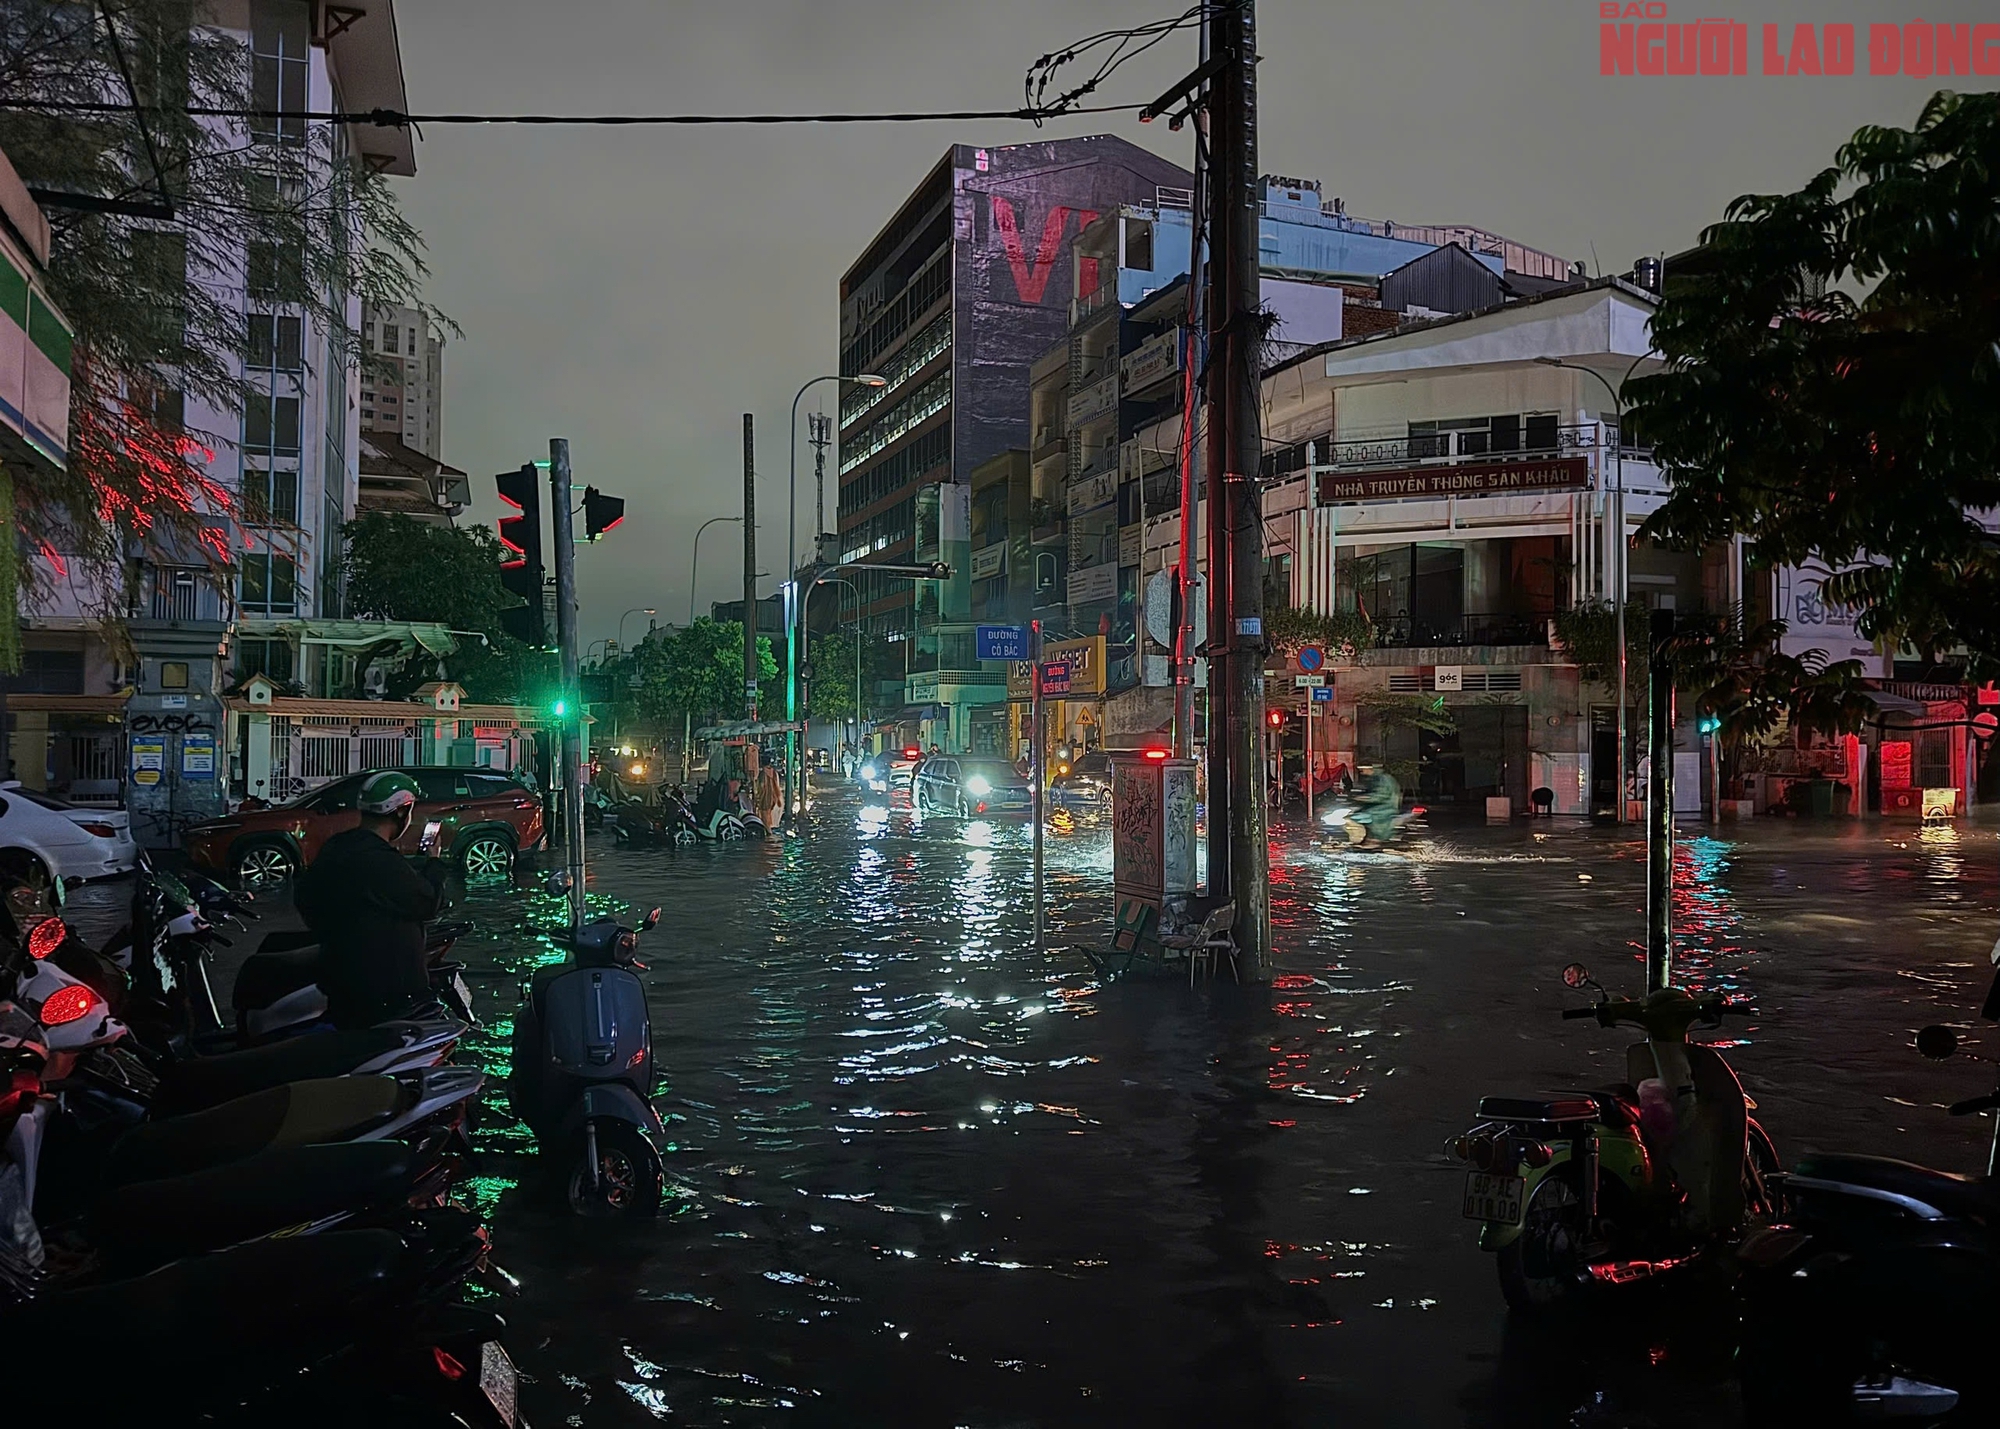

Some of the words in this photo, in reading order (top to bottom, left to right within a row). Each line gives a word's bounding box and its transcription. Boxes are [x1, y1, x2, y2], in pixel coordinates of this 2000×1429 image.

[1335, 479, 1364, 497] NHÀ
[1369, 472, 1426, 495] TRUYỀN
[1431, 469, 1483, 491] THỐNG
[988, 629, 1018, 640] ĐƯỜNG
[991, 643, 1001, 656] CÔ
[1004, 641, 1018, 656] BẮC
[1439, 673, 1457, 683] góc
